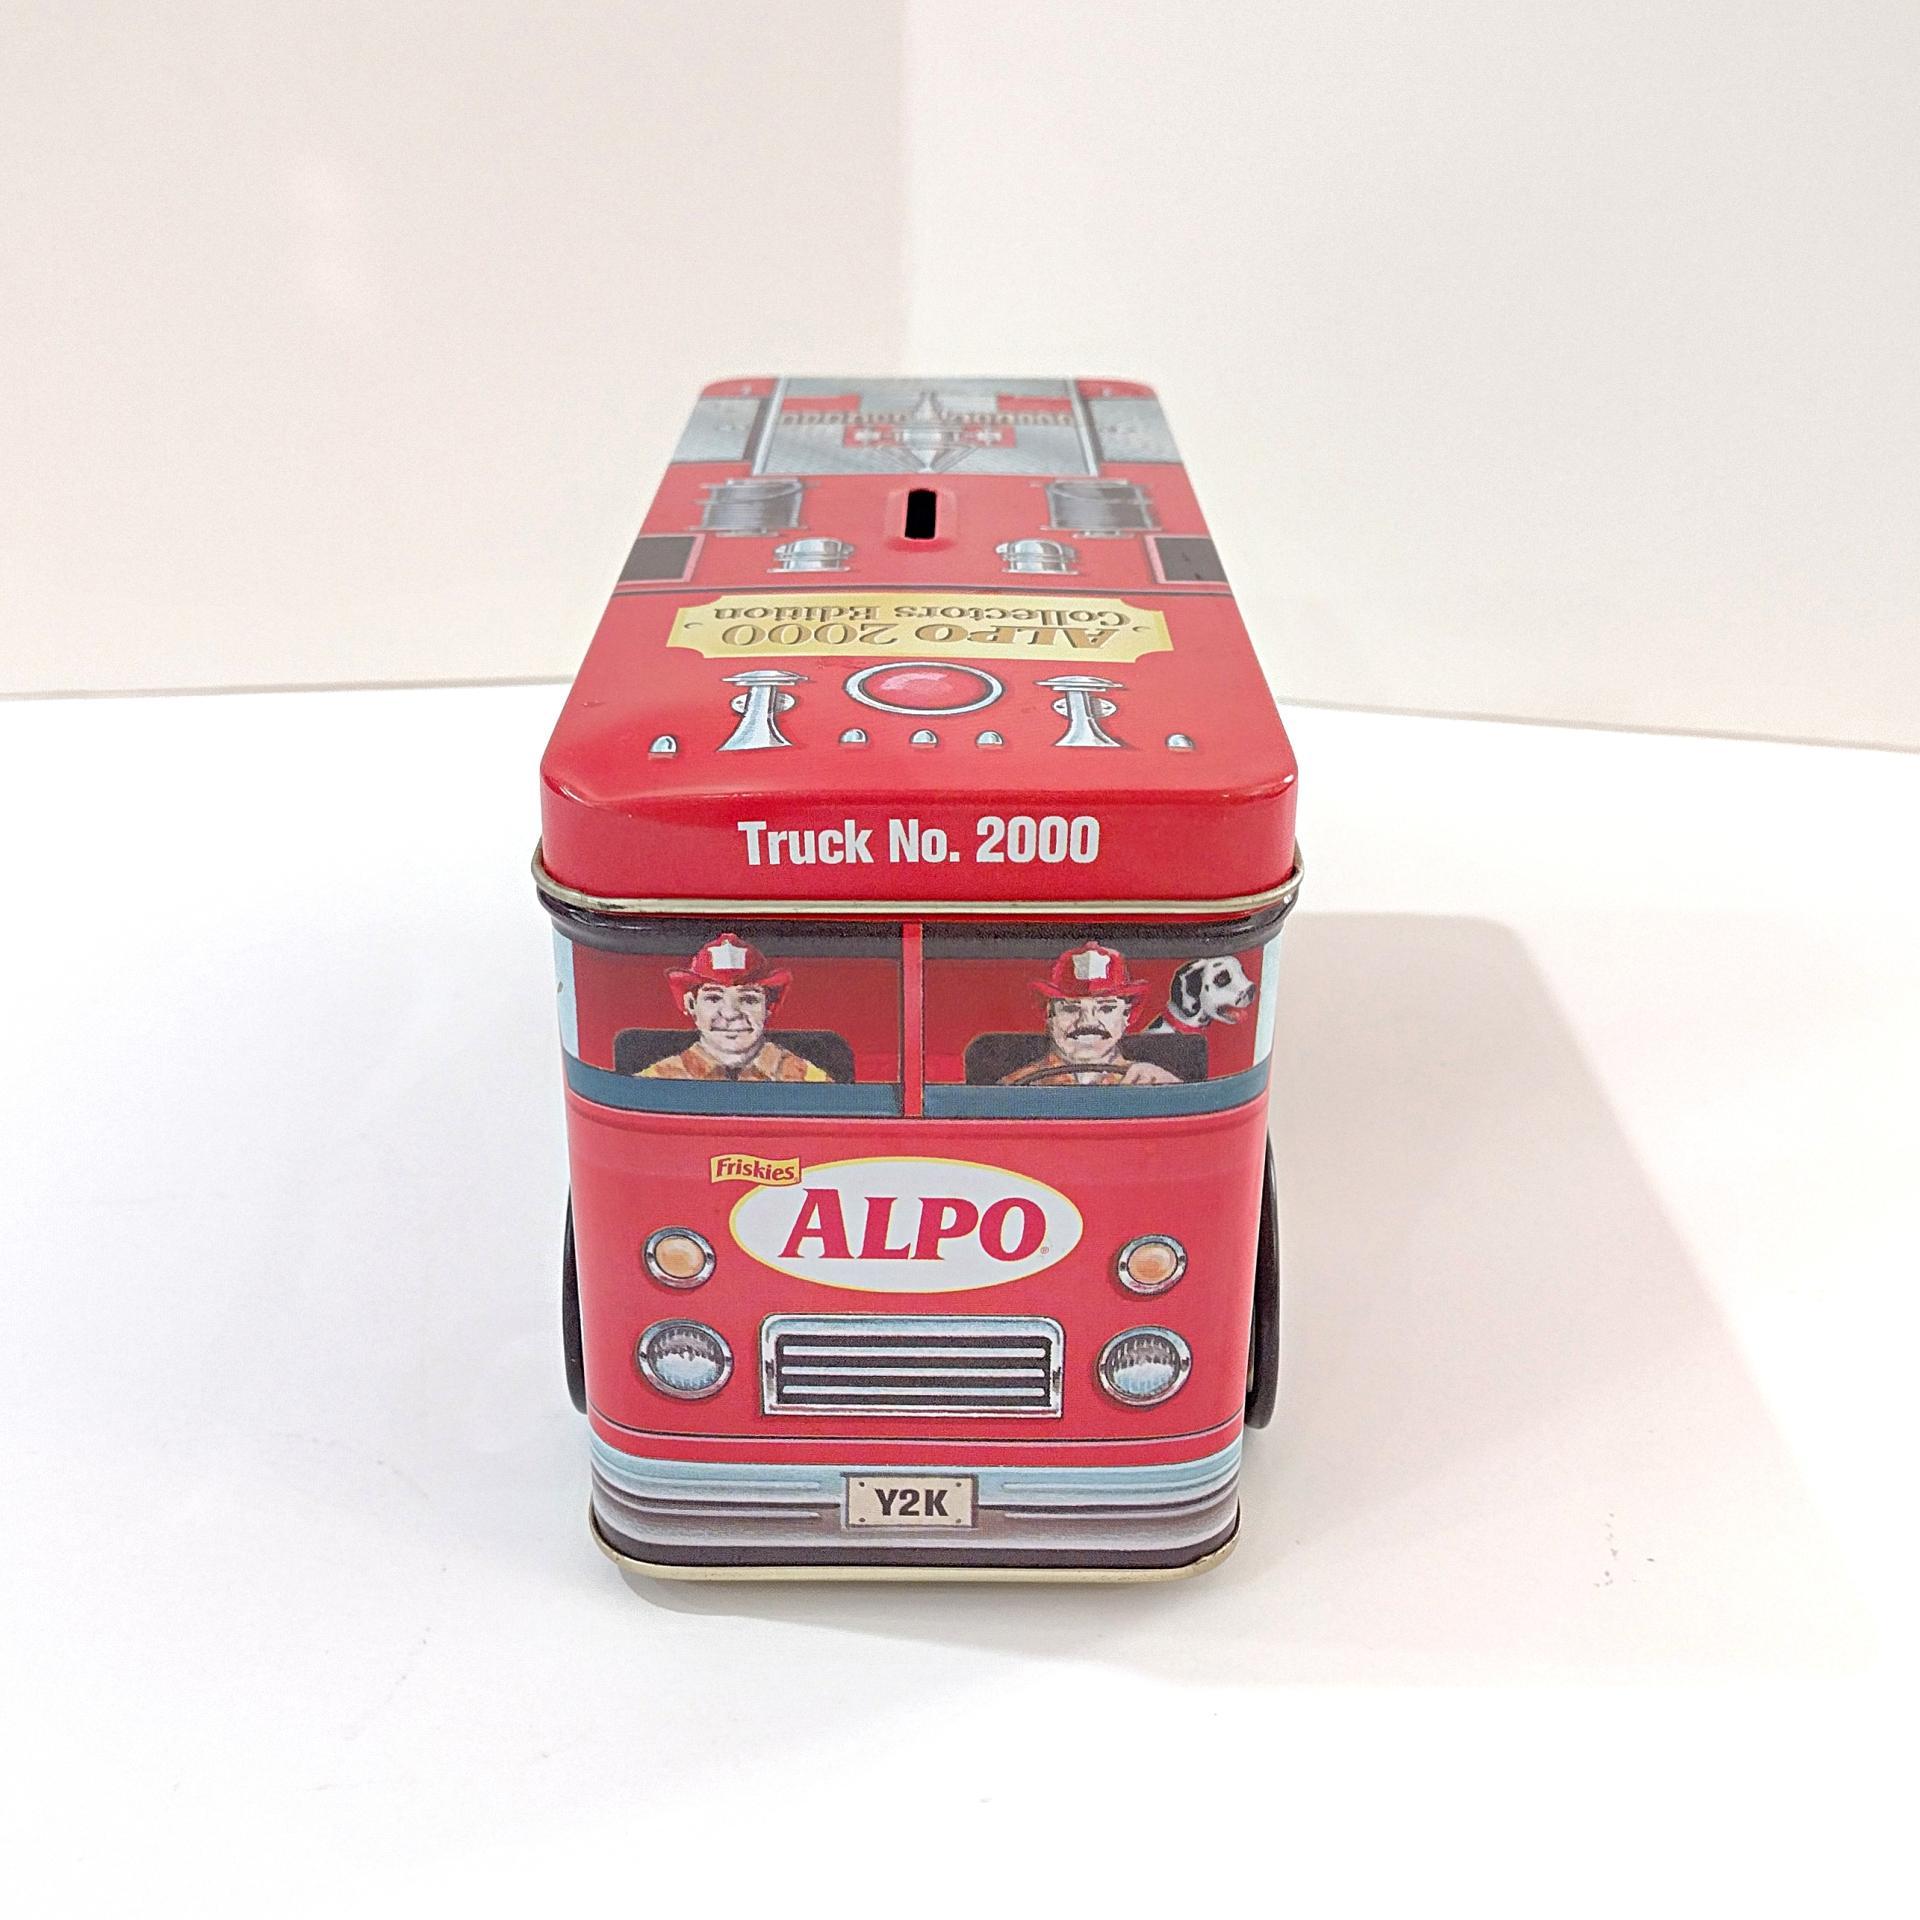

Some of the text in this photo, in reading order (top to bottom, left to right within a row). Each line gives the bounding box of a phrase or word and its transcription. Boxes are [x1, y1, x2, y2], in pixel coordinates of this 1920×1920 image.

[714, 606, 1128, 626] Collectors Edition
[722, 623, 1120, 648] ALPO 2000
[737, 815, 1101, 866] Truck No. 2000
[716, 1157, 795, 1181] Friskies
[777, 1188, 1047, 1262] ALPO
[874, 1488, 949, 1517] Y2K
